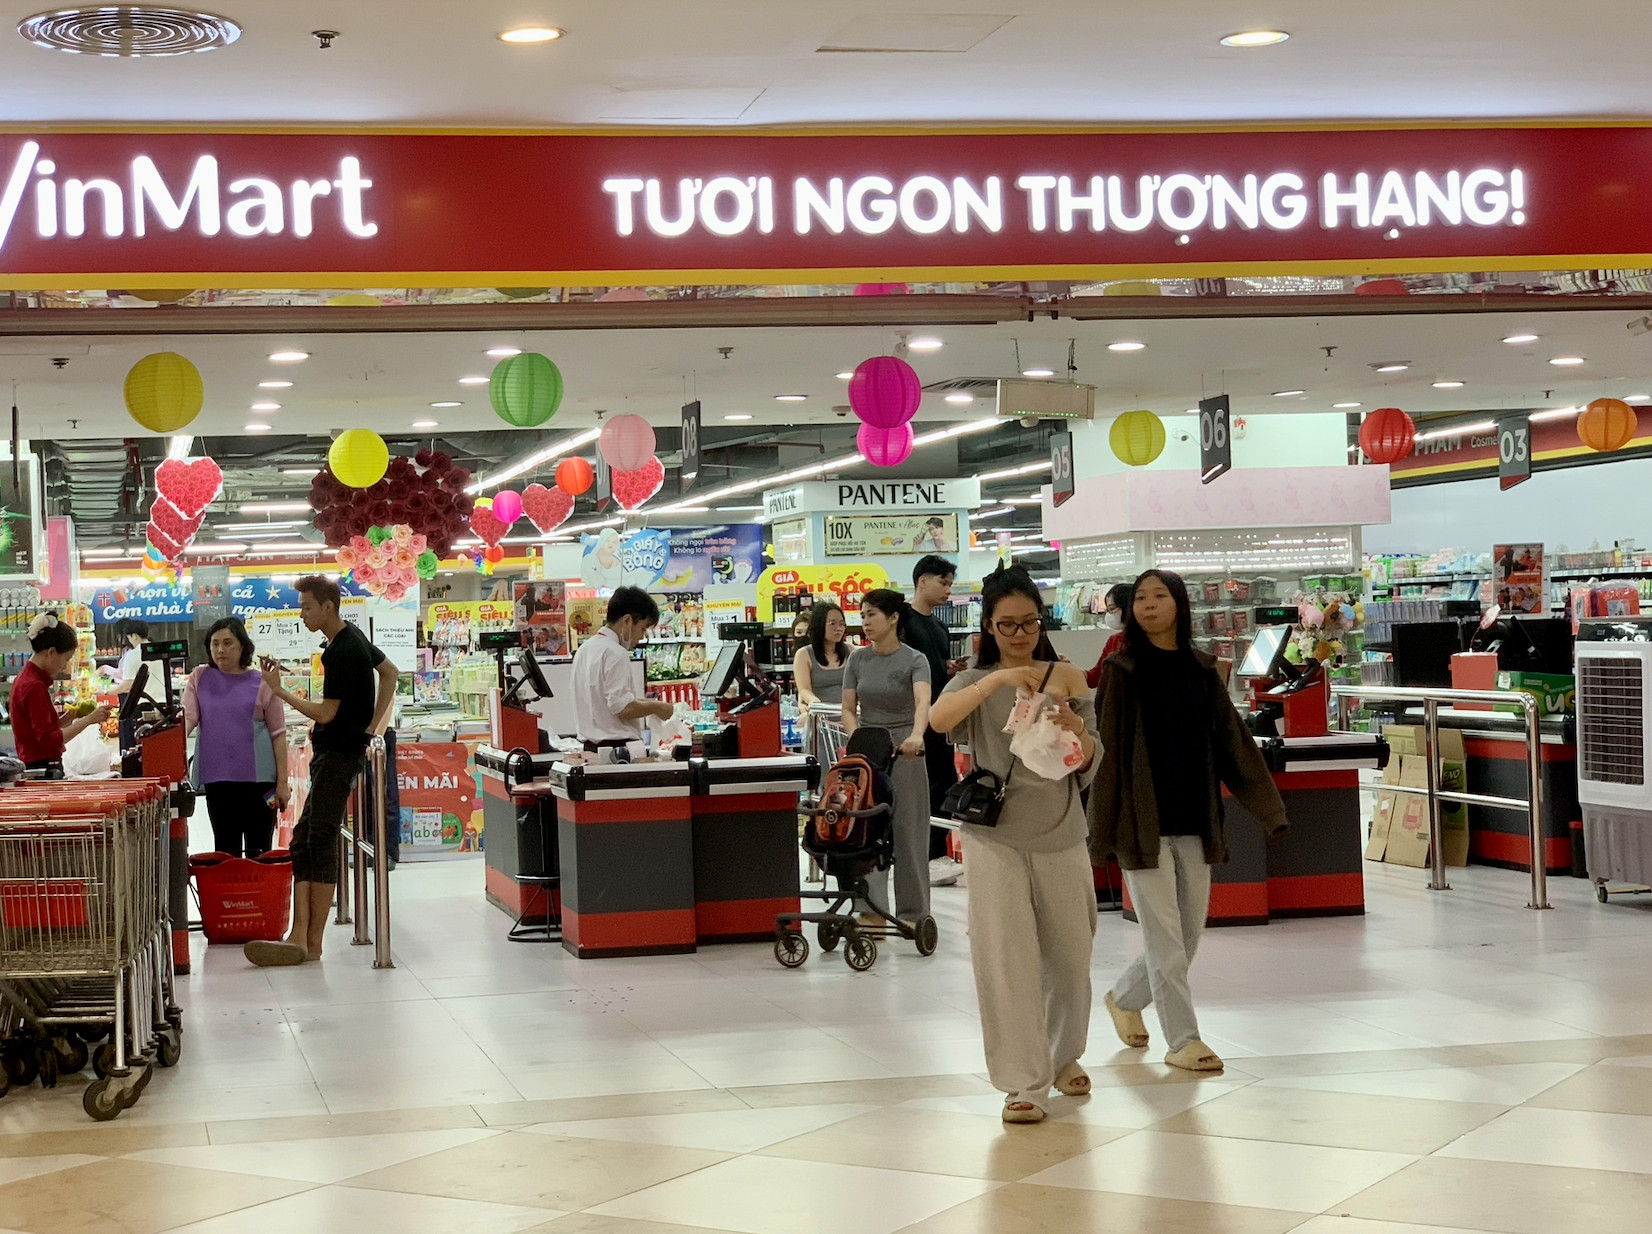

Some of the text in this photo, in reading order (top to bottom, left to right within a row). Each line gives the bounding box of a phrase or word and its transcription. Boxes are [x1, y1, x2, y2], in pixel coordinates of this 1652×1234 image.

[602, 168, 1525, 245] TƯƠI NGON THƯỢNG HẠNG!
[682, 416, 697, 459] 08
[1201, 409, 1227, 451] 06
[1501, 429, 1527, 464] 03
[1052, 446, 1070, 480] 05
[769, 488, 797, 513] PANTENE
[839, 483, 946, 506] PANTENE
[829, 522, 853, 539] 10X
[864, 521, 896, 529] PANTENE
[633, 535, 663, 553] GIẤY
[623, 551, 665, 572] BÔNG
[775, 570, 795, 583] GIÁ
[829, 572, 874, 597] SỐC
[232, 584, 255, 599] cả
[103, 604, 142, 620] Cơm
[146, 602, 184, 616] nhà
[259, 624, 271, 634] 27
[294, 622, 299, 634] 1
[424, 772, 458, 789] MÃI
